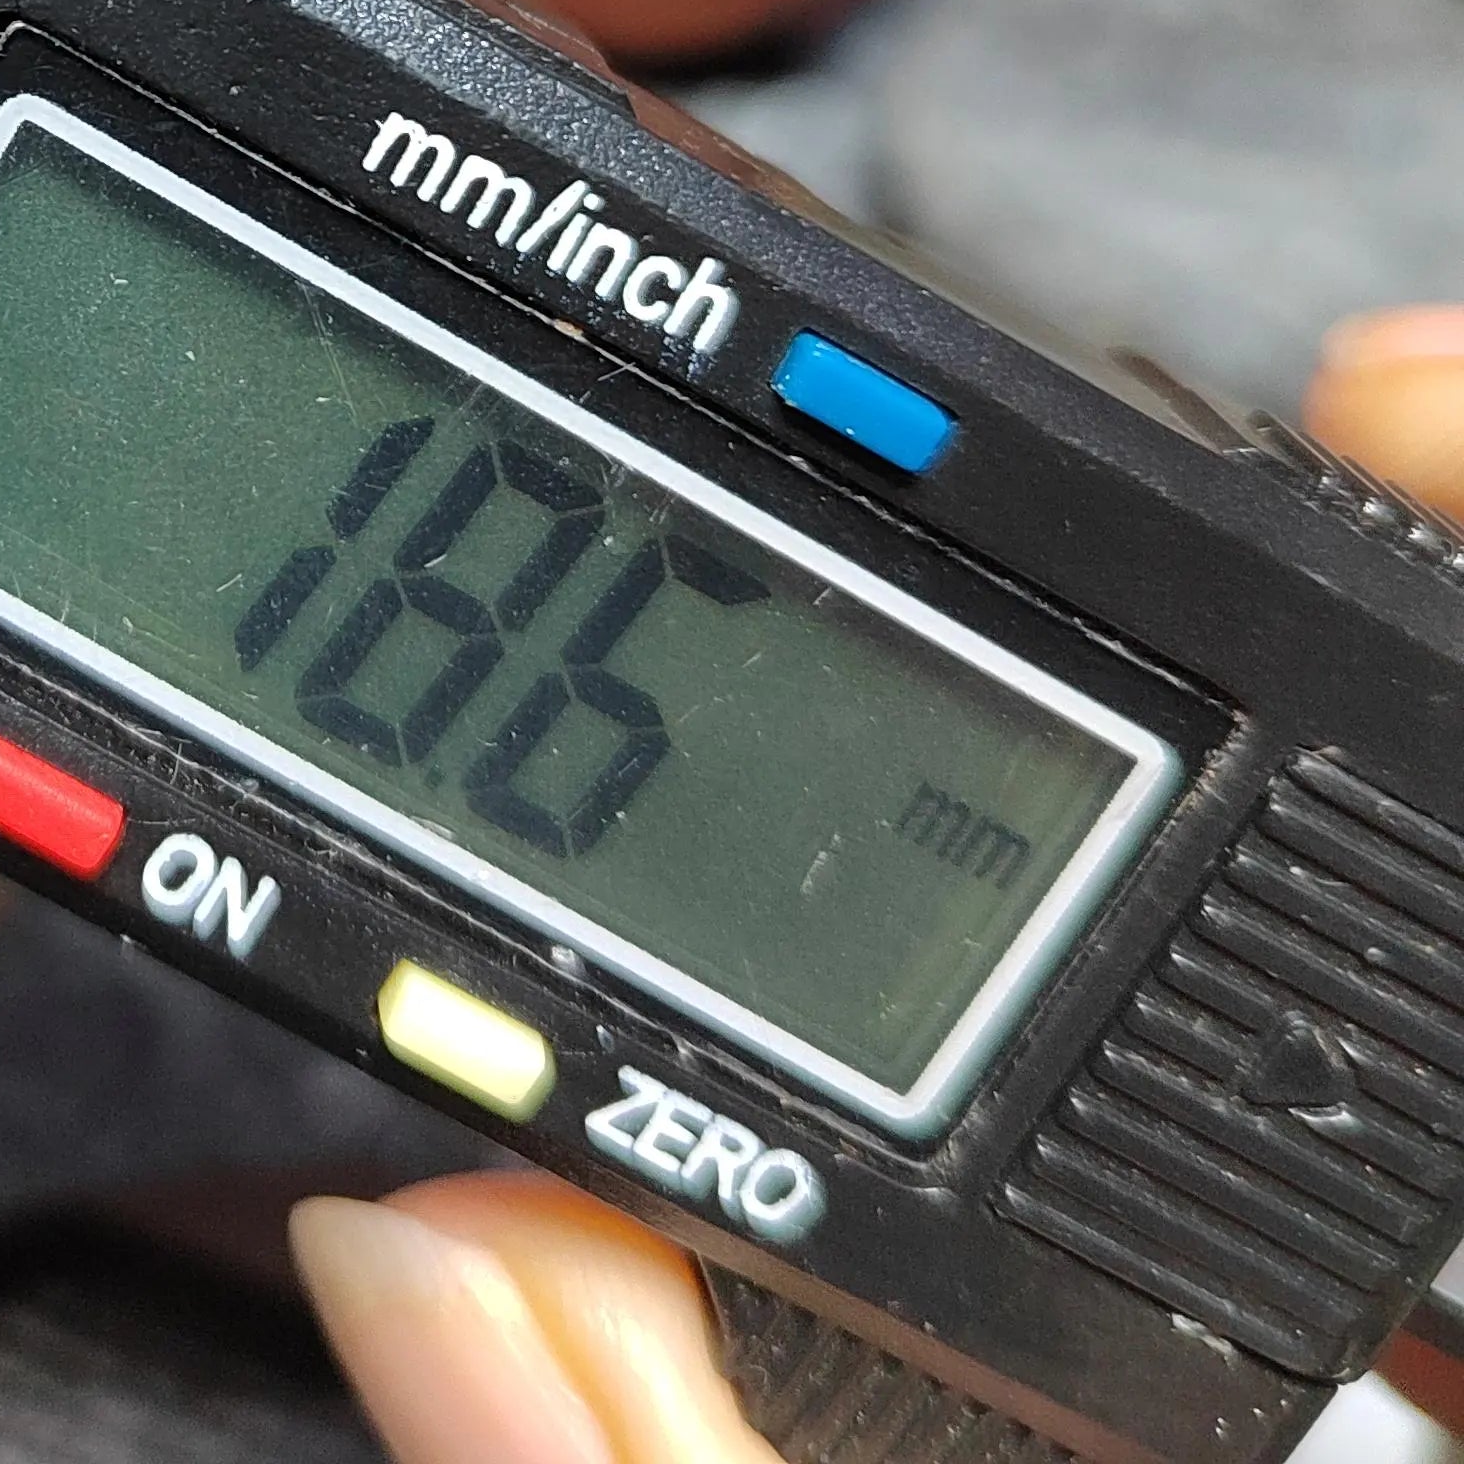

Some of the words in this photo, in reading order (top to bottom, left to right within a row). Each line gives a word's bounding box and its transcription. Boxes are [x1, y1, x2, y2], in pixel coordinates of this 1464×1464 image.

[361, 110, 737, 354] mm/inch
[140, 832, 282, 960] ON
[898, 782, 1031, 888] mm
[584, 1066, 827, 1244] ZERO
